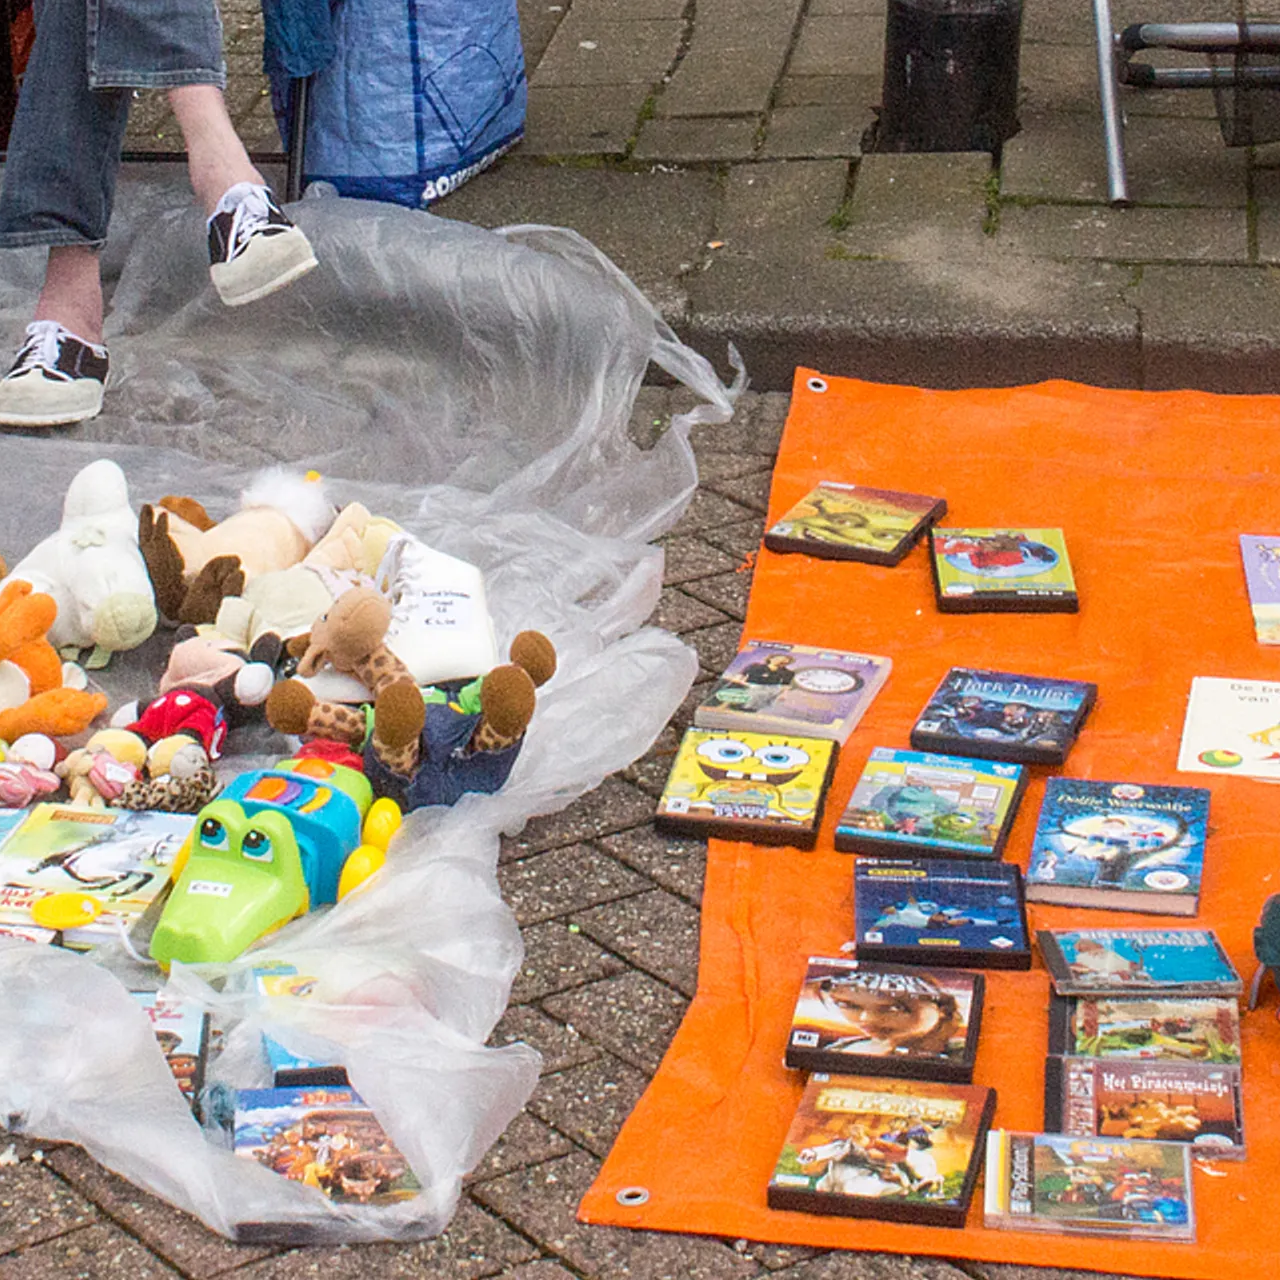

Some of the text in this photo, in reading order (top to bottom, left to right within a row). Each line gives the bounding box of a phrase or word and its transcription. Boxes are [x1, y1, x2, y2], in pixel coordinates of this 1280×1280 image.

[1056, 793, 1193, 813] Dolfje Weerwolfje
[1102, 1072, 1126, 1090] Het
